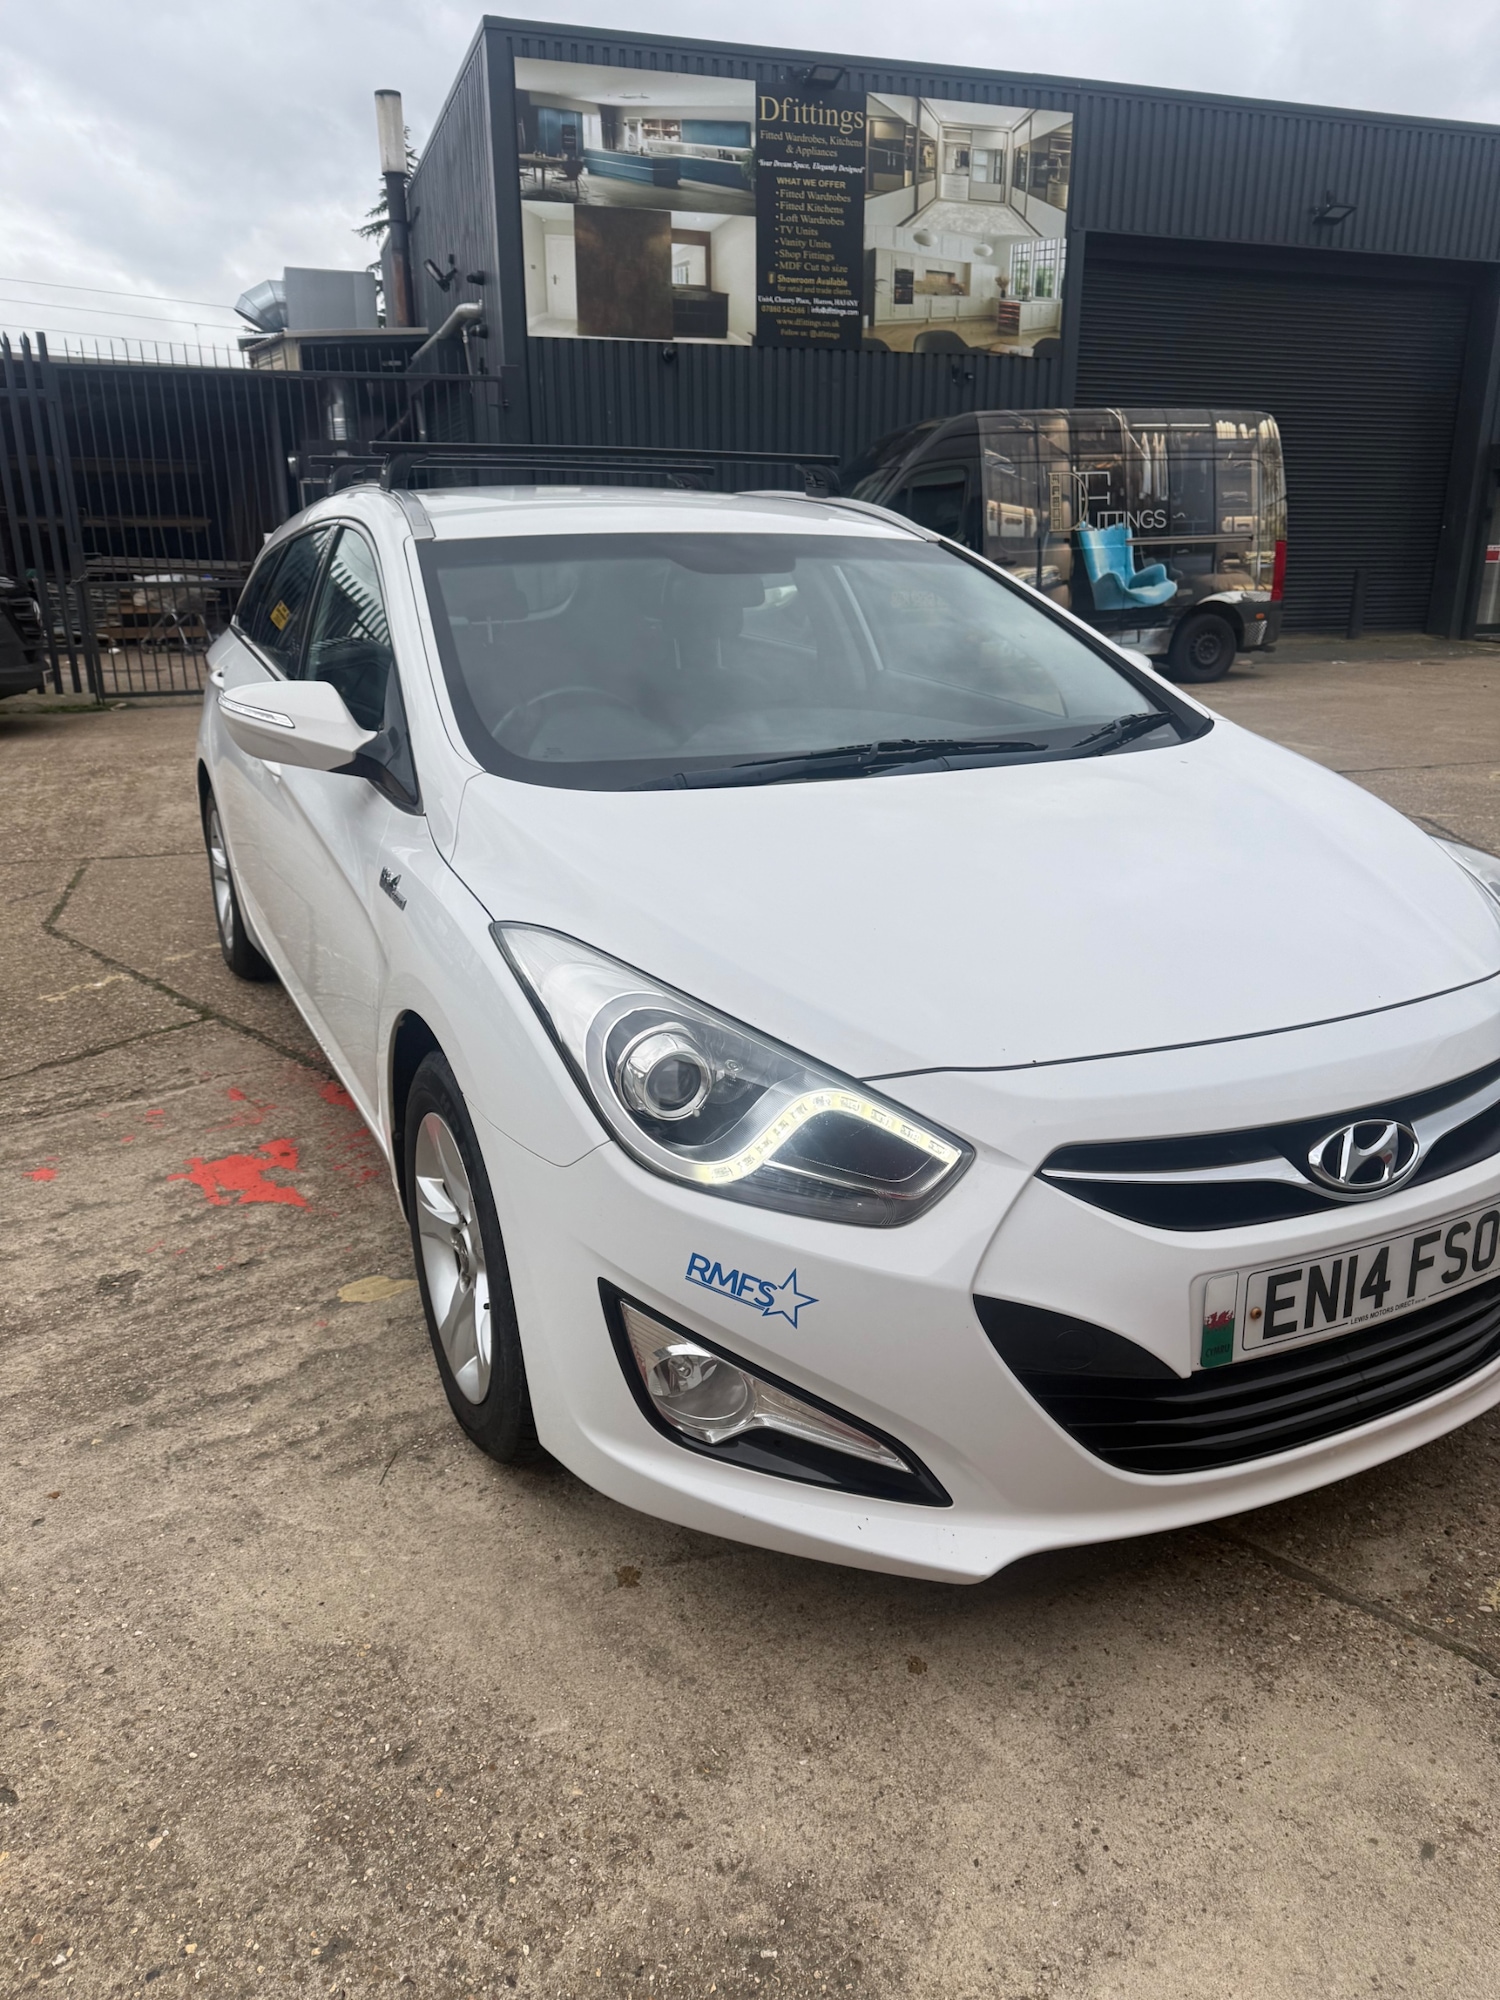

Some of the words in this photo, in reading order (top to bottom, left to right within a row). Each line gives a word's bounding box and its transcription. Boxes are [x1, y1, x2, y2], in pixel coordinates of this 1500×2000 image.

[759, 95, 864, 134] Dfittings
[760, 130, 783, 141] Fitted
[830, 136, 863, 148] Kitchens
[786, 144, 794, 154] &
[795, 146, 838, 157] Appliances
[773, 160, 792, 168] Dream
[776, 176, 801, 186] WHAT
[803, 178, 817, 187] WE
[818, 179, 847, 189] OFFER
[780, 188, 805, 199] Fitted
[807, 190, 852, 203] Wardrobes
[780, 200, 805, 212] Fitted
[806, 202, 844, 214] Kitchens
[780, 213, 799, 223] Loft
[800, 214, 845, 226] Wardrobes
[780, 225, 794, 235] TV
[795, 226, 819, 236] Units
[779, 237, 807, 249] Vanity
[808, 239, 832, 249] Units
[779, 249, 801, 260] Shop
[803, 250, 835, 262] Fittings
[779, 261, 802, 271] MDF
[803, 262, 819, 272] Cut
[821, 264, 831, 272] to
[777, 274, 815, 285] Showroom
[816, 276, 848, 287] Available
[686, 1251, 778, 1308] RMFS
[1262, 1246, 1391, 1341] EN14
[1406, 1209, 1500, 1299] FSO
[1350, 1314, 1369, 1325] LEWIS
[1369, 1305, 1394, 1320] MOTORS
[1394, 1298, 1416, 1311] DIRECT
